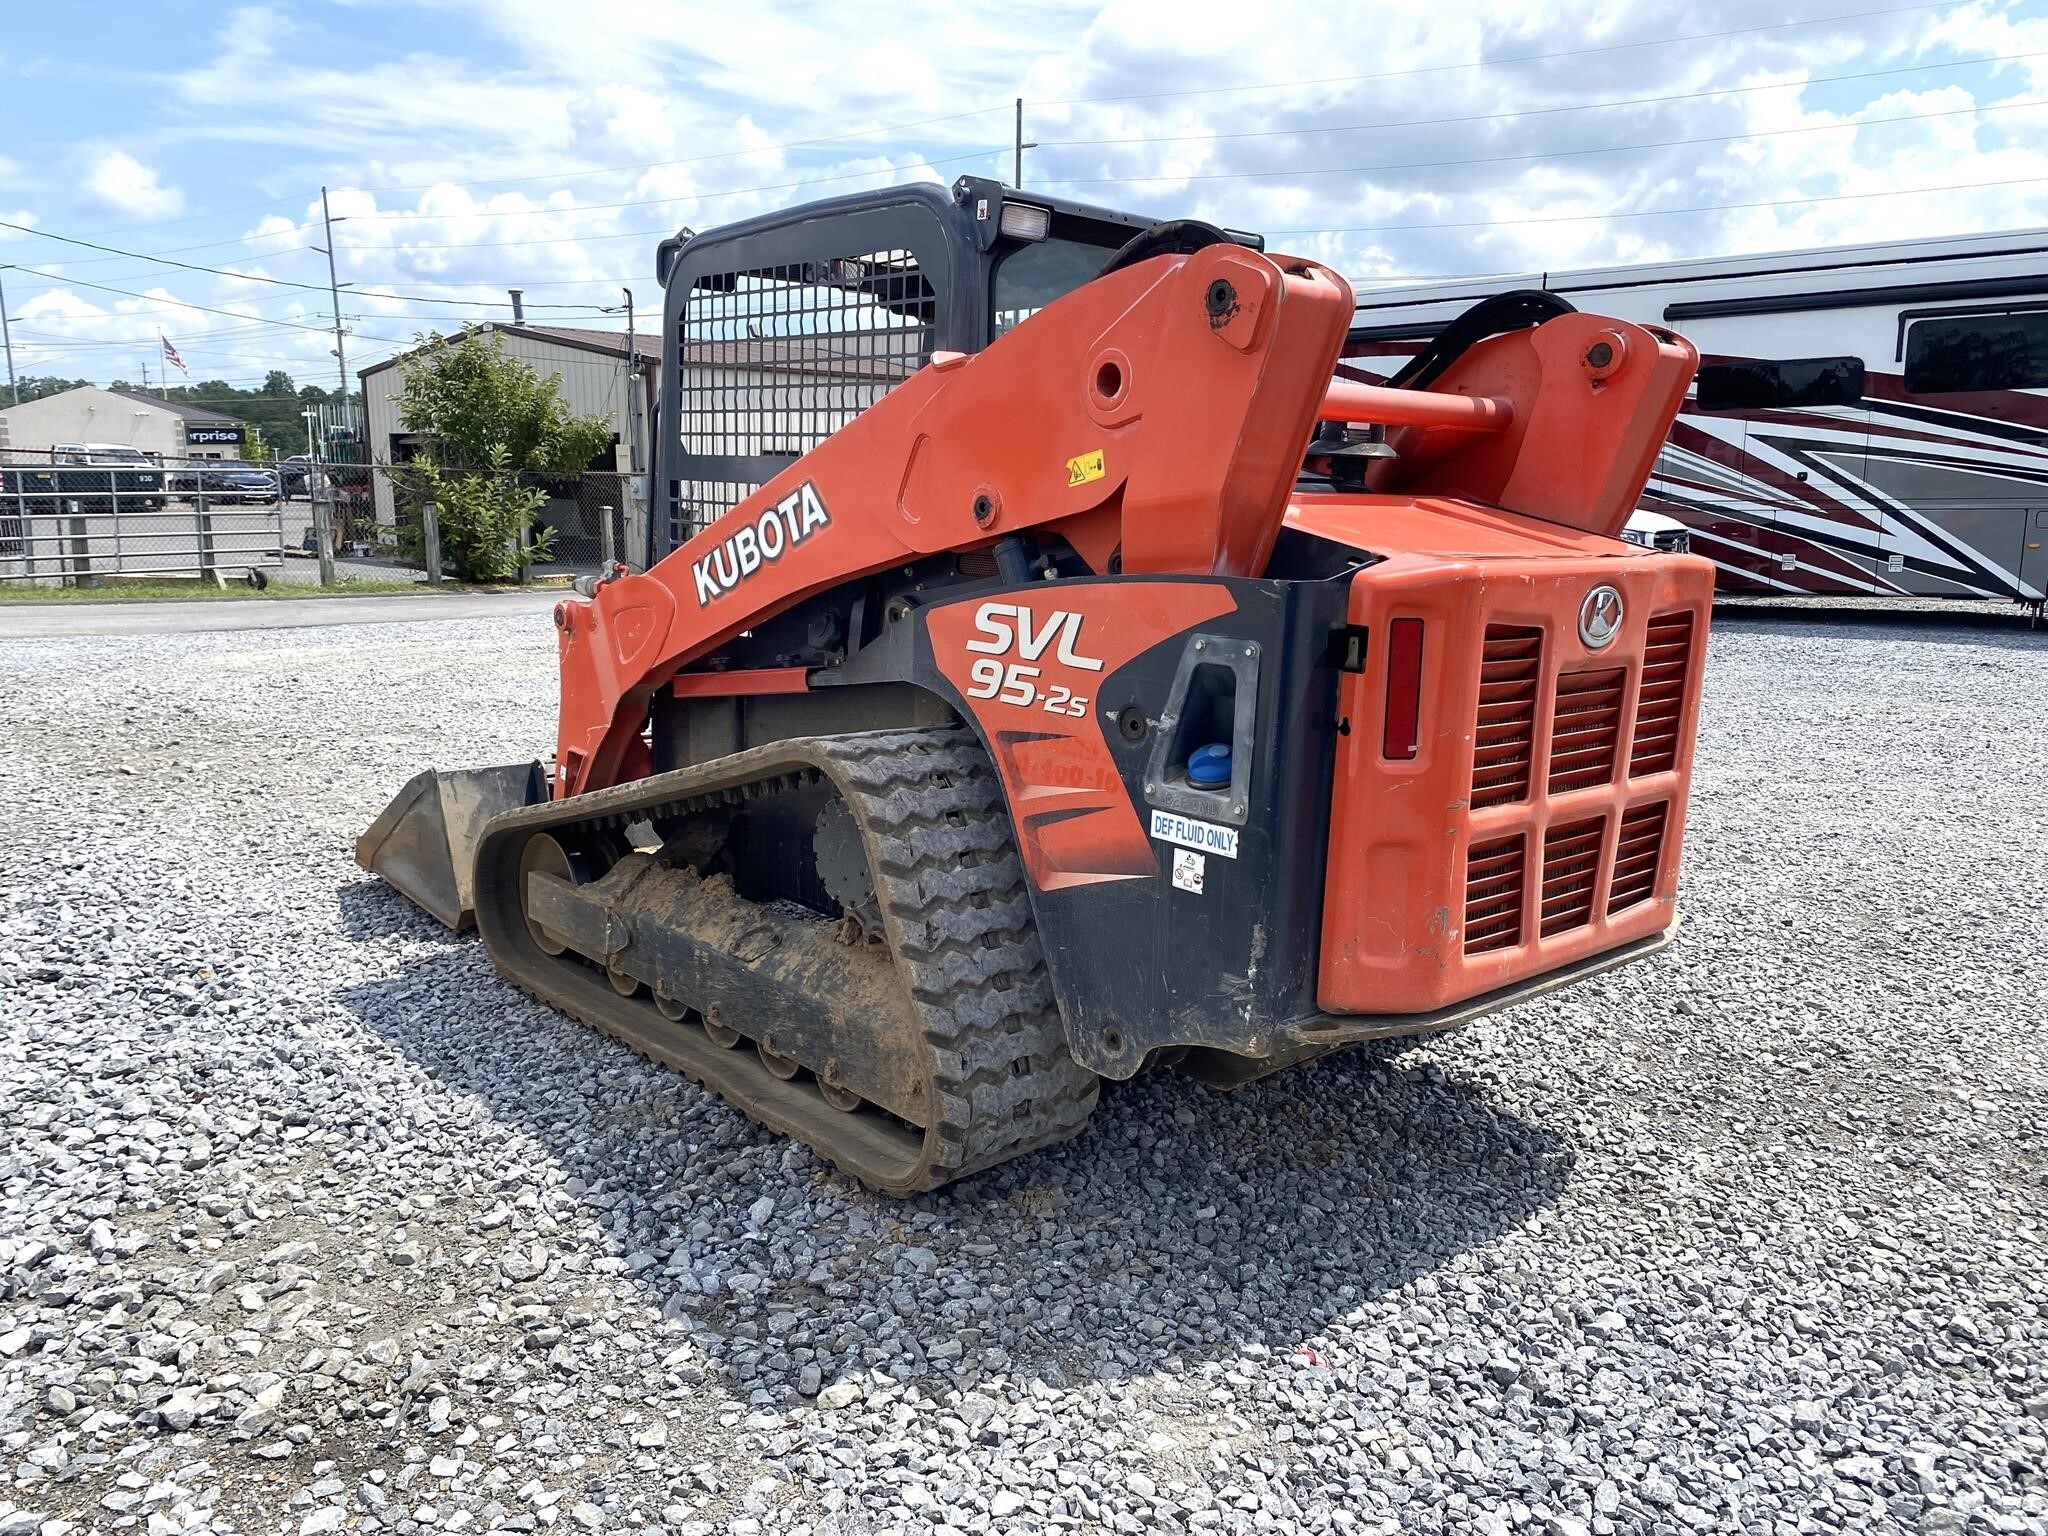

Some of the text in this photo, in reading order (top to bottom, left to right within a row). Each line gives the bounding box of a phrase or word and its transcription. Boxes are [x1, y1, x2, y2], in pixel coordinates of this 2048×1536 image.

[190, 430, 238, 443] rprise
[692, 482, 829, 606] KUBOTA
[966, 602, 1104, 672] SVL
[1155, 815, 1234, 852] DEF FLUID ONLY
